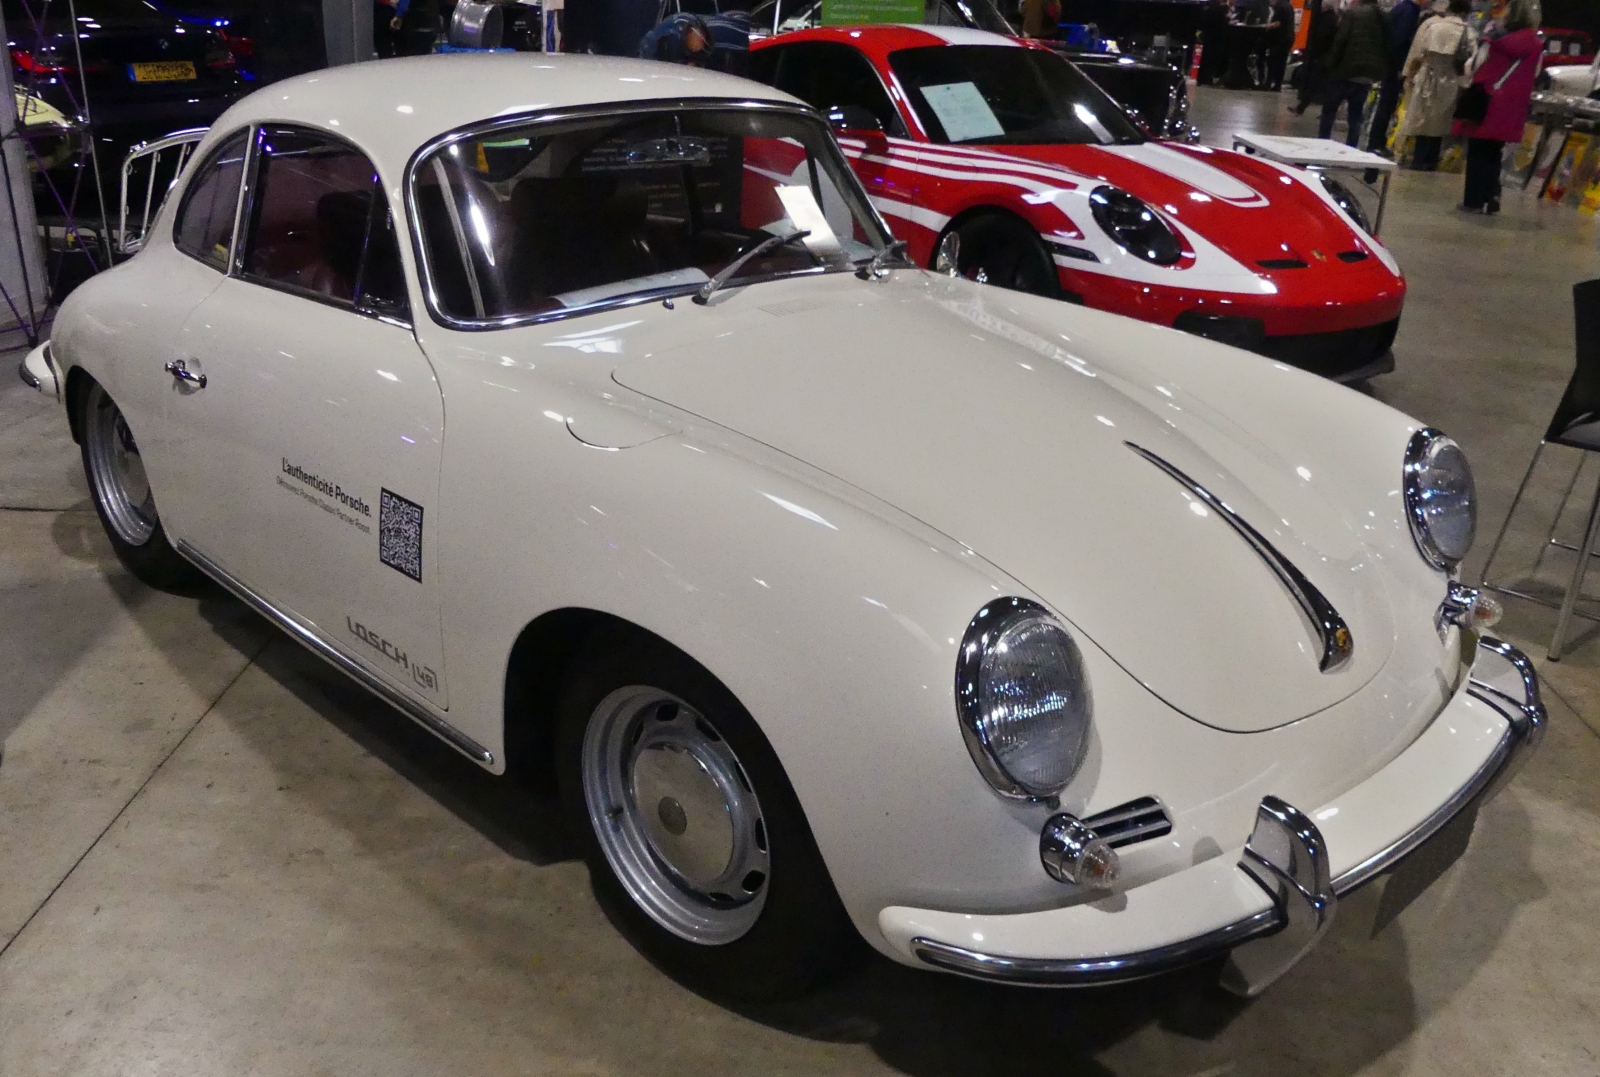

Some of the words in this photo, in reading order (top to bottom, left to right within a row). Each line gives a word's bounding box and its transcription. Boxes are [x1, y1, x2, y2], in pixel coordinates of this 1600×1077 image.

[282, 457, 334, 498] L'authenticité
[335, 485, 372, 518] Porsche.
[346, 615, 409, 669] LOSCH
